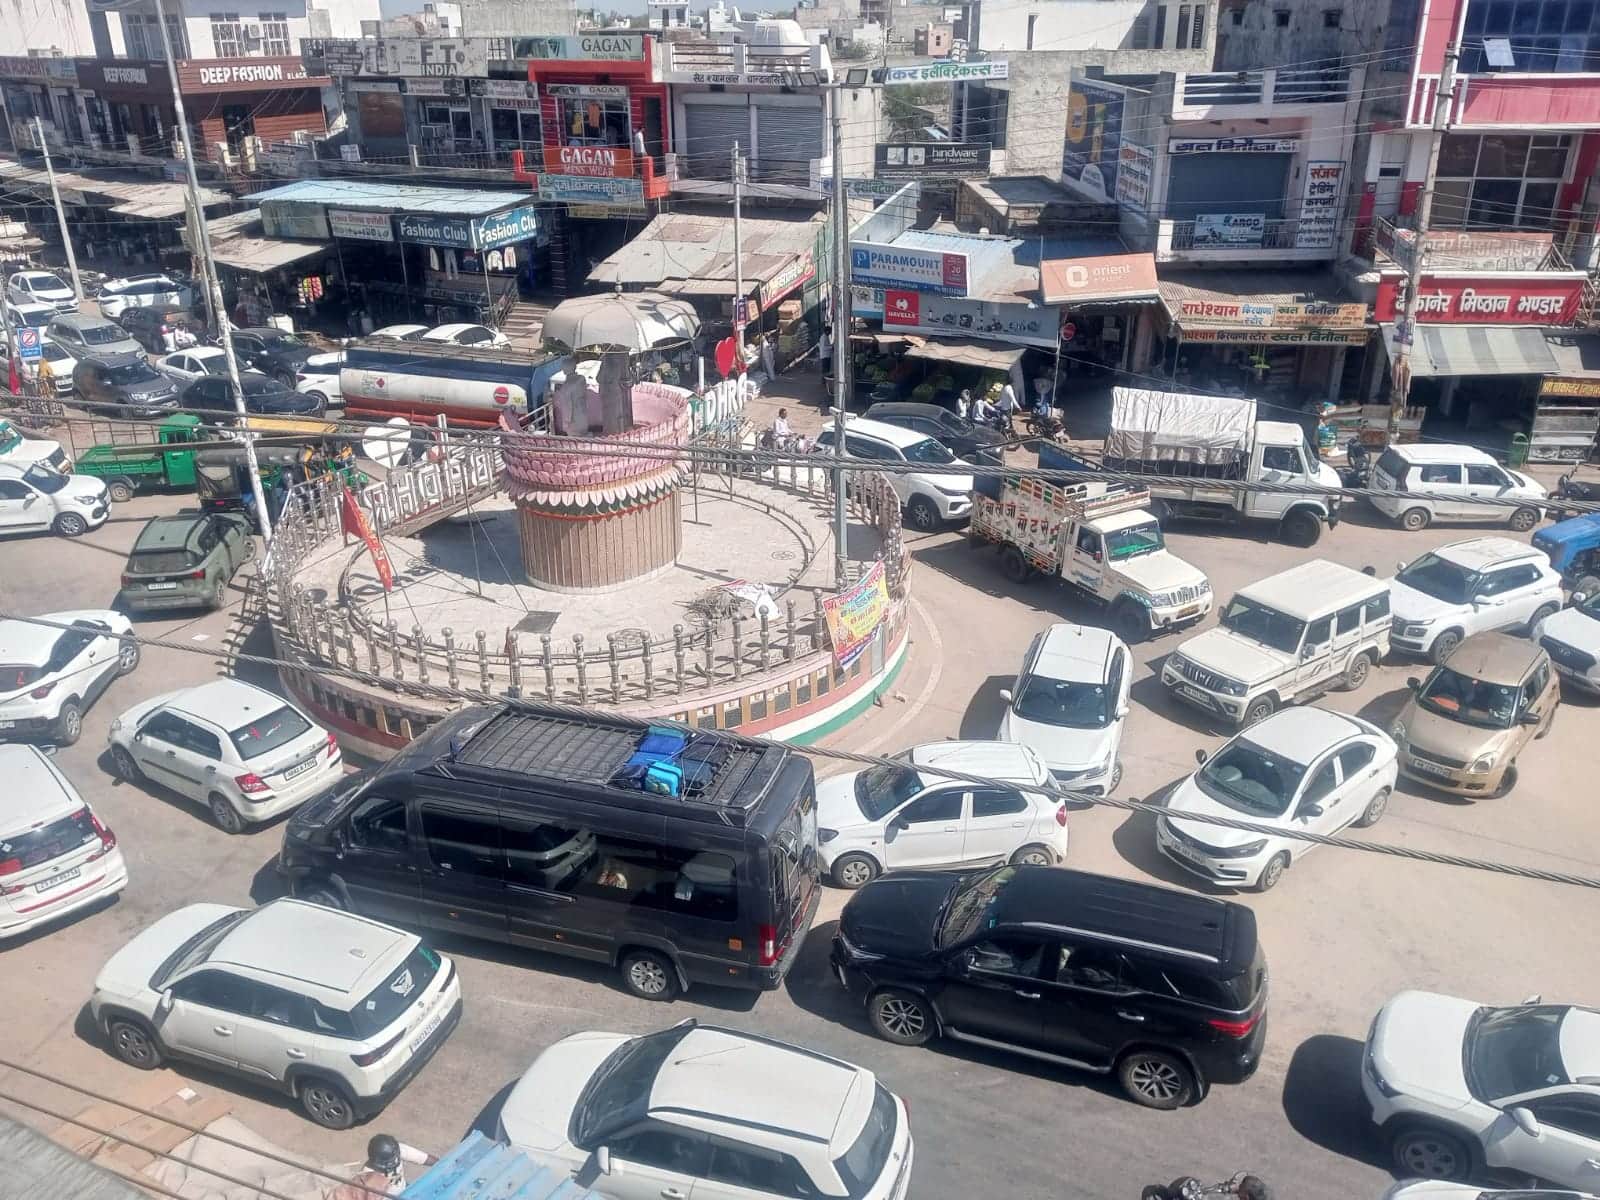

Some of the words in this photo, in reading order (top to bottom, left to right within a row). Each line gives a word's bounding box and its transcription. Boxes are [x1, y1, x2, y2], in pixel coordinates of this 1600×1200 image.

[581, 39, 632, 52] GAGAN
[200, 65, 231, 84] DEEP
[232, 64, 283, 82] FASHION
[419, 64, 457, 76] INDIA
[560, 148, 615, 167] GAGAN
[932, 148, 978, 158] hindware
[590, 166, 615, 177] WEAR
[1310, 165, 1341, 179] संजय
[400, 221, 441, 239] Fashion
[442, 225, 468, 241] Club
[478, 222, 519, 245] Fashion
[870, 252, 940, 270] PARAMOUNT
[1093, 263, 1131, 277] orient
[1459, 287, 1512, 314] मिष्ठान
[1517, 294, 1566, 316] भण्डार
[1182, 303, 1240, 318] राधेश्याम
